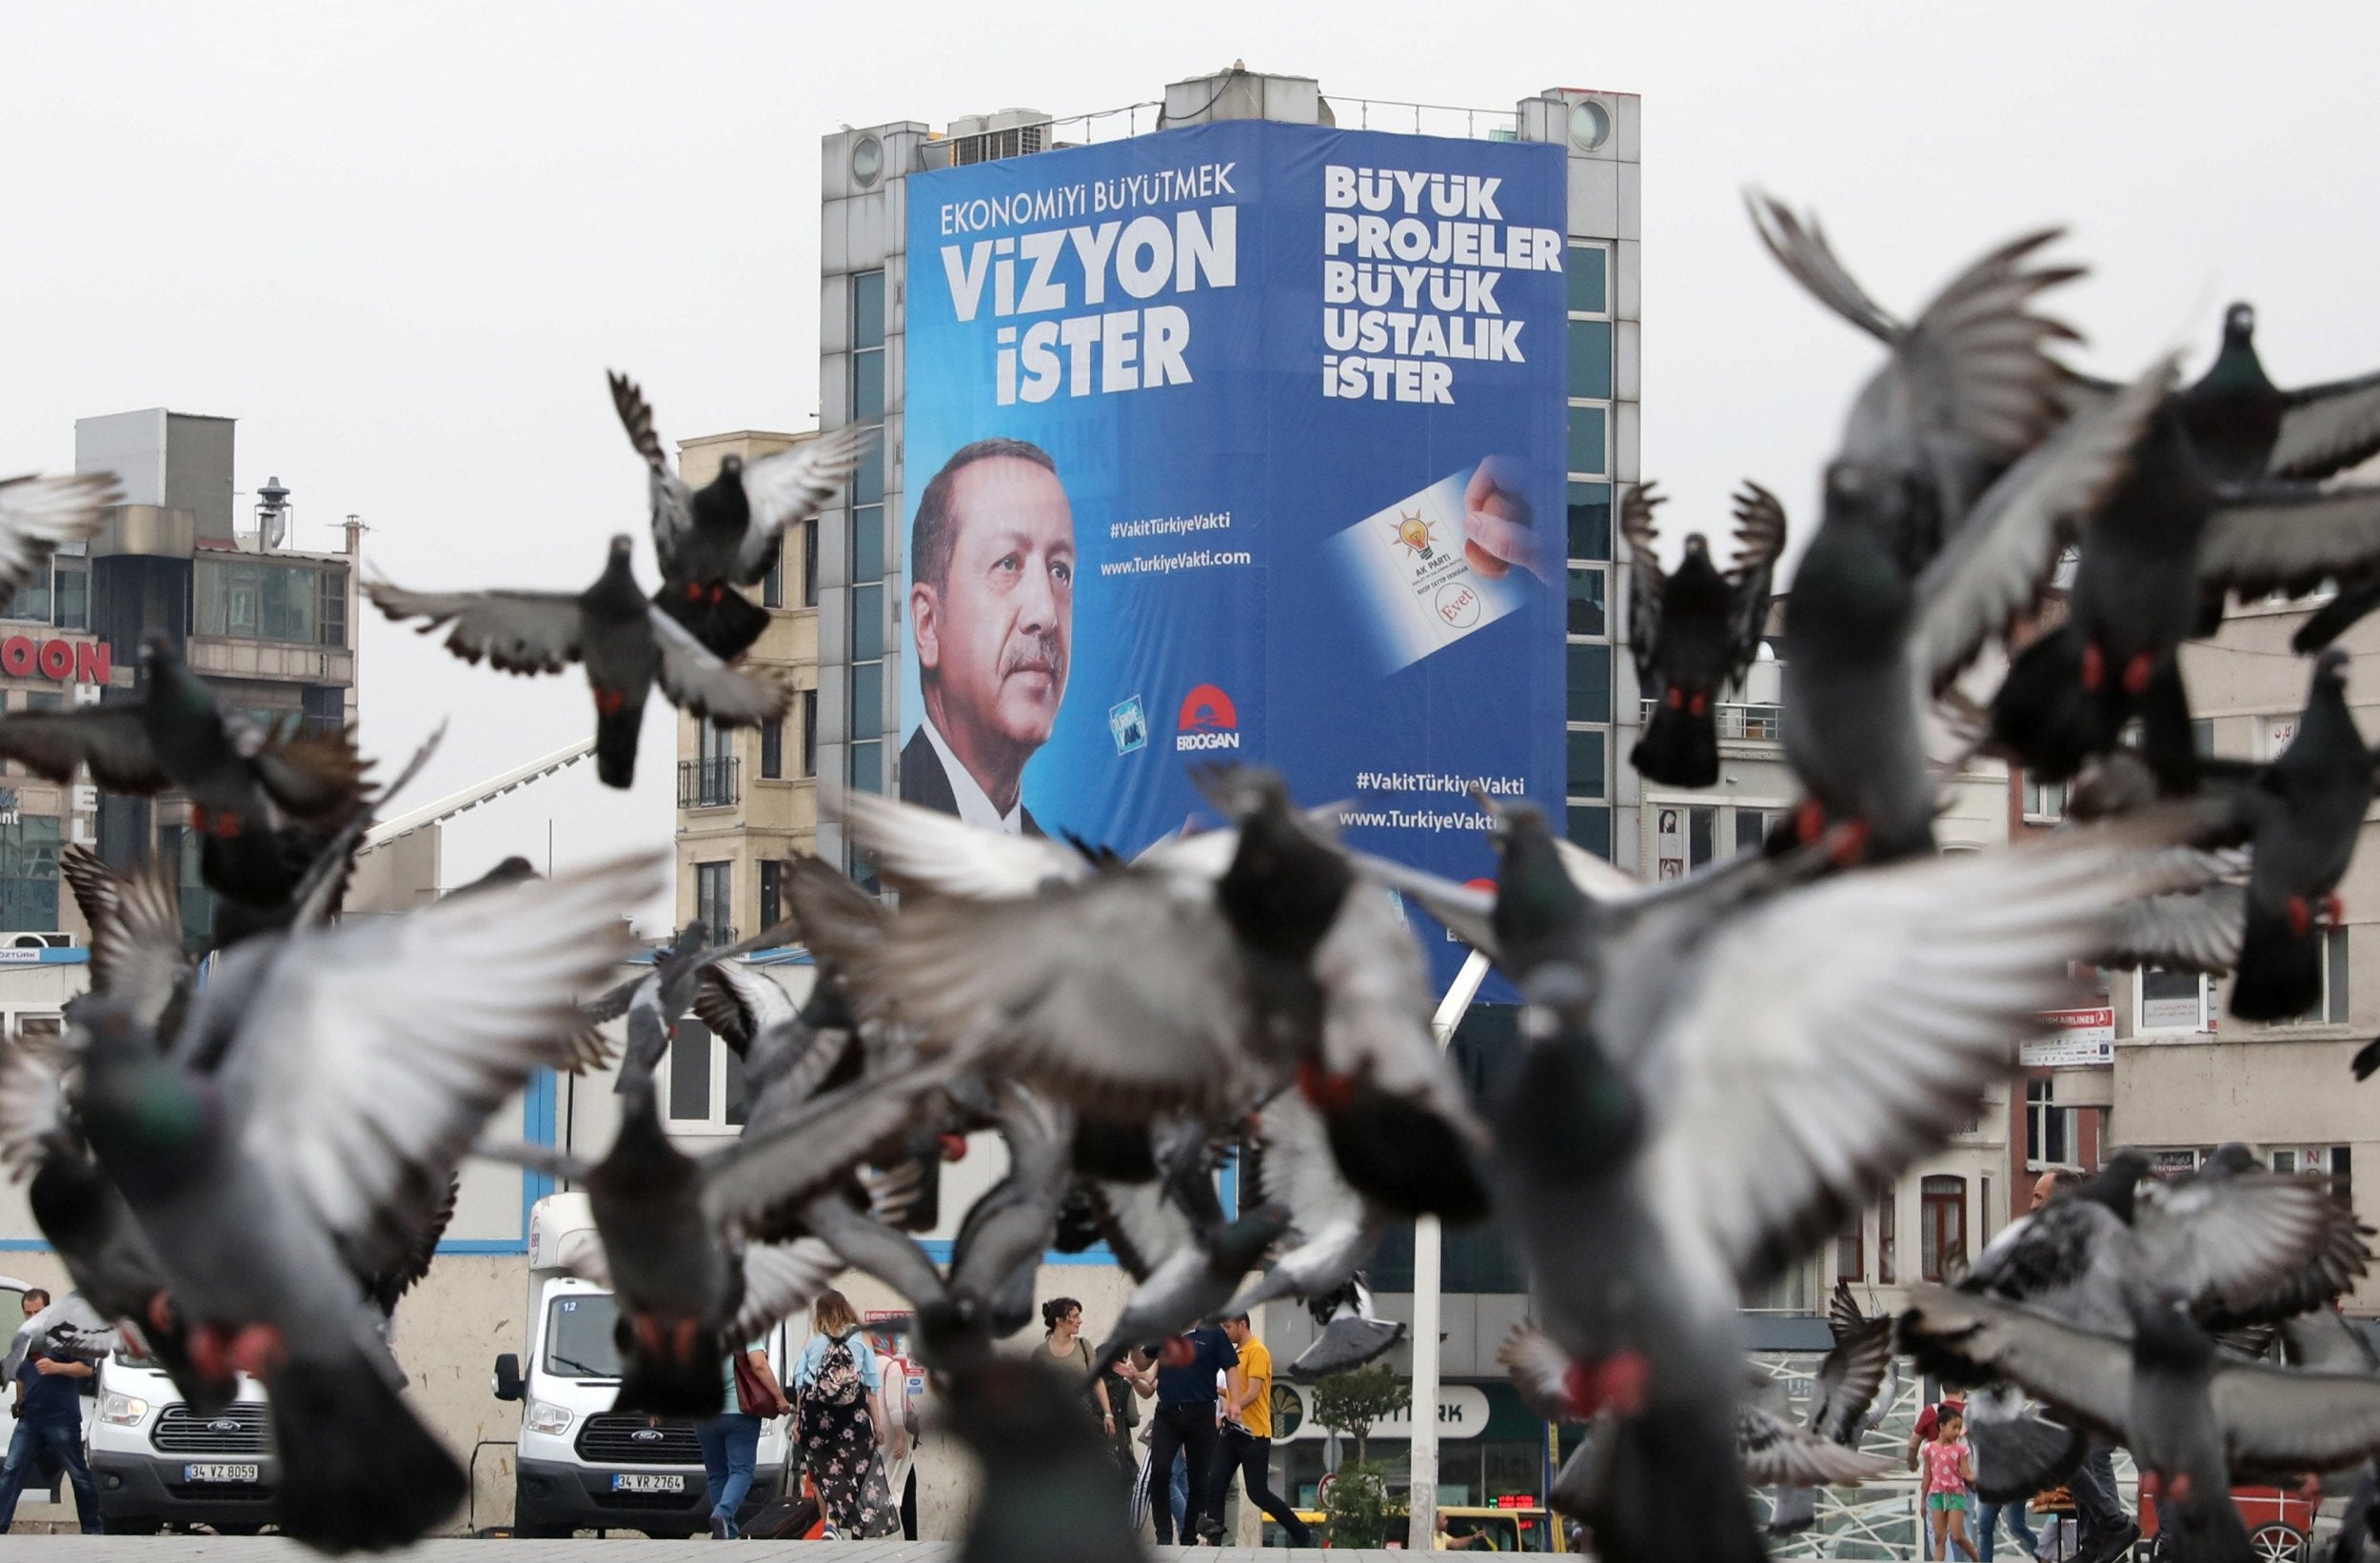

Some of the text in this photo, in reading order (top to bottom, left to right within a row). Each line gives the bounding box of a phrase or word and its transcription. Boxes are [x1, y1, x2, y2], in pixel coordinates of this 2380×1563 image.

[1094, 163, 1236, 212] BÜYÜTMEK
[1324, 165, 1503, 220] BÜYÜK
[1324, 212, 1562, 272] PROJELER
[1324, 260, 1502, 314] BÜYÜK
[1323, 307, 1525, 363] USTALIK
[1110, 511, 1231, 539] #VakitTürkiyeVakti
[1101, 550, 1251, 576] www.TurkiyeVakti.com
[1416, 565, 1428, 578] AK
[1440, 588, 1474, 622] Evet
[1356, 772, 1525, 797] #VakitTürkiyeVakti
[1339, 810, 1498, 833] www.TurkiyeVakti
[192, 1466, 255, 1478] 34 VZ 8059
[637, 1475, 649, 1488] VR
[654, 1476, 681, 1489] 2764
